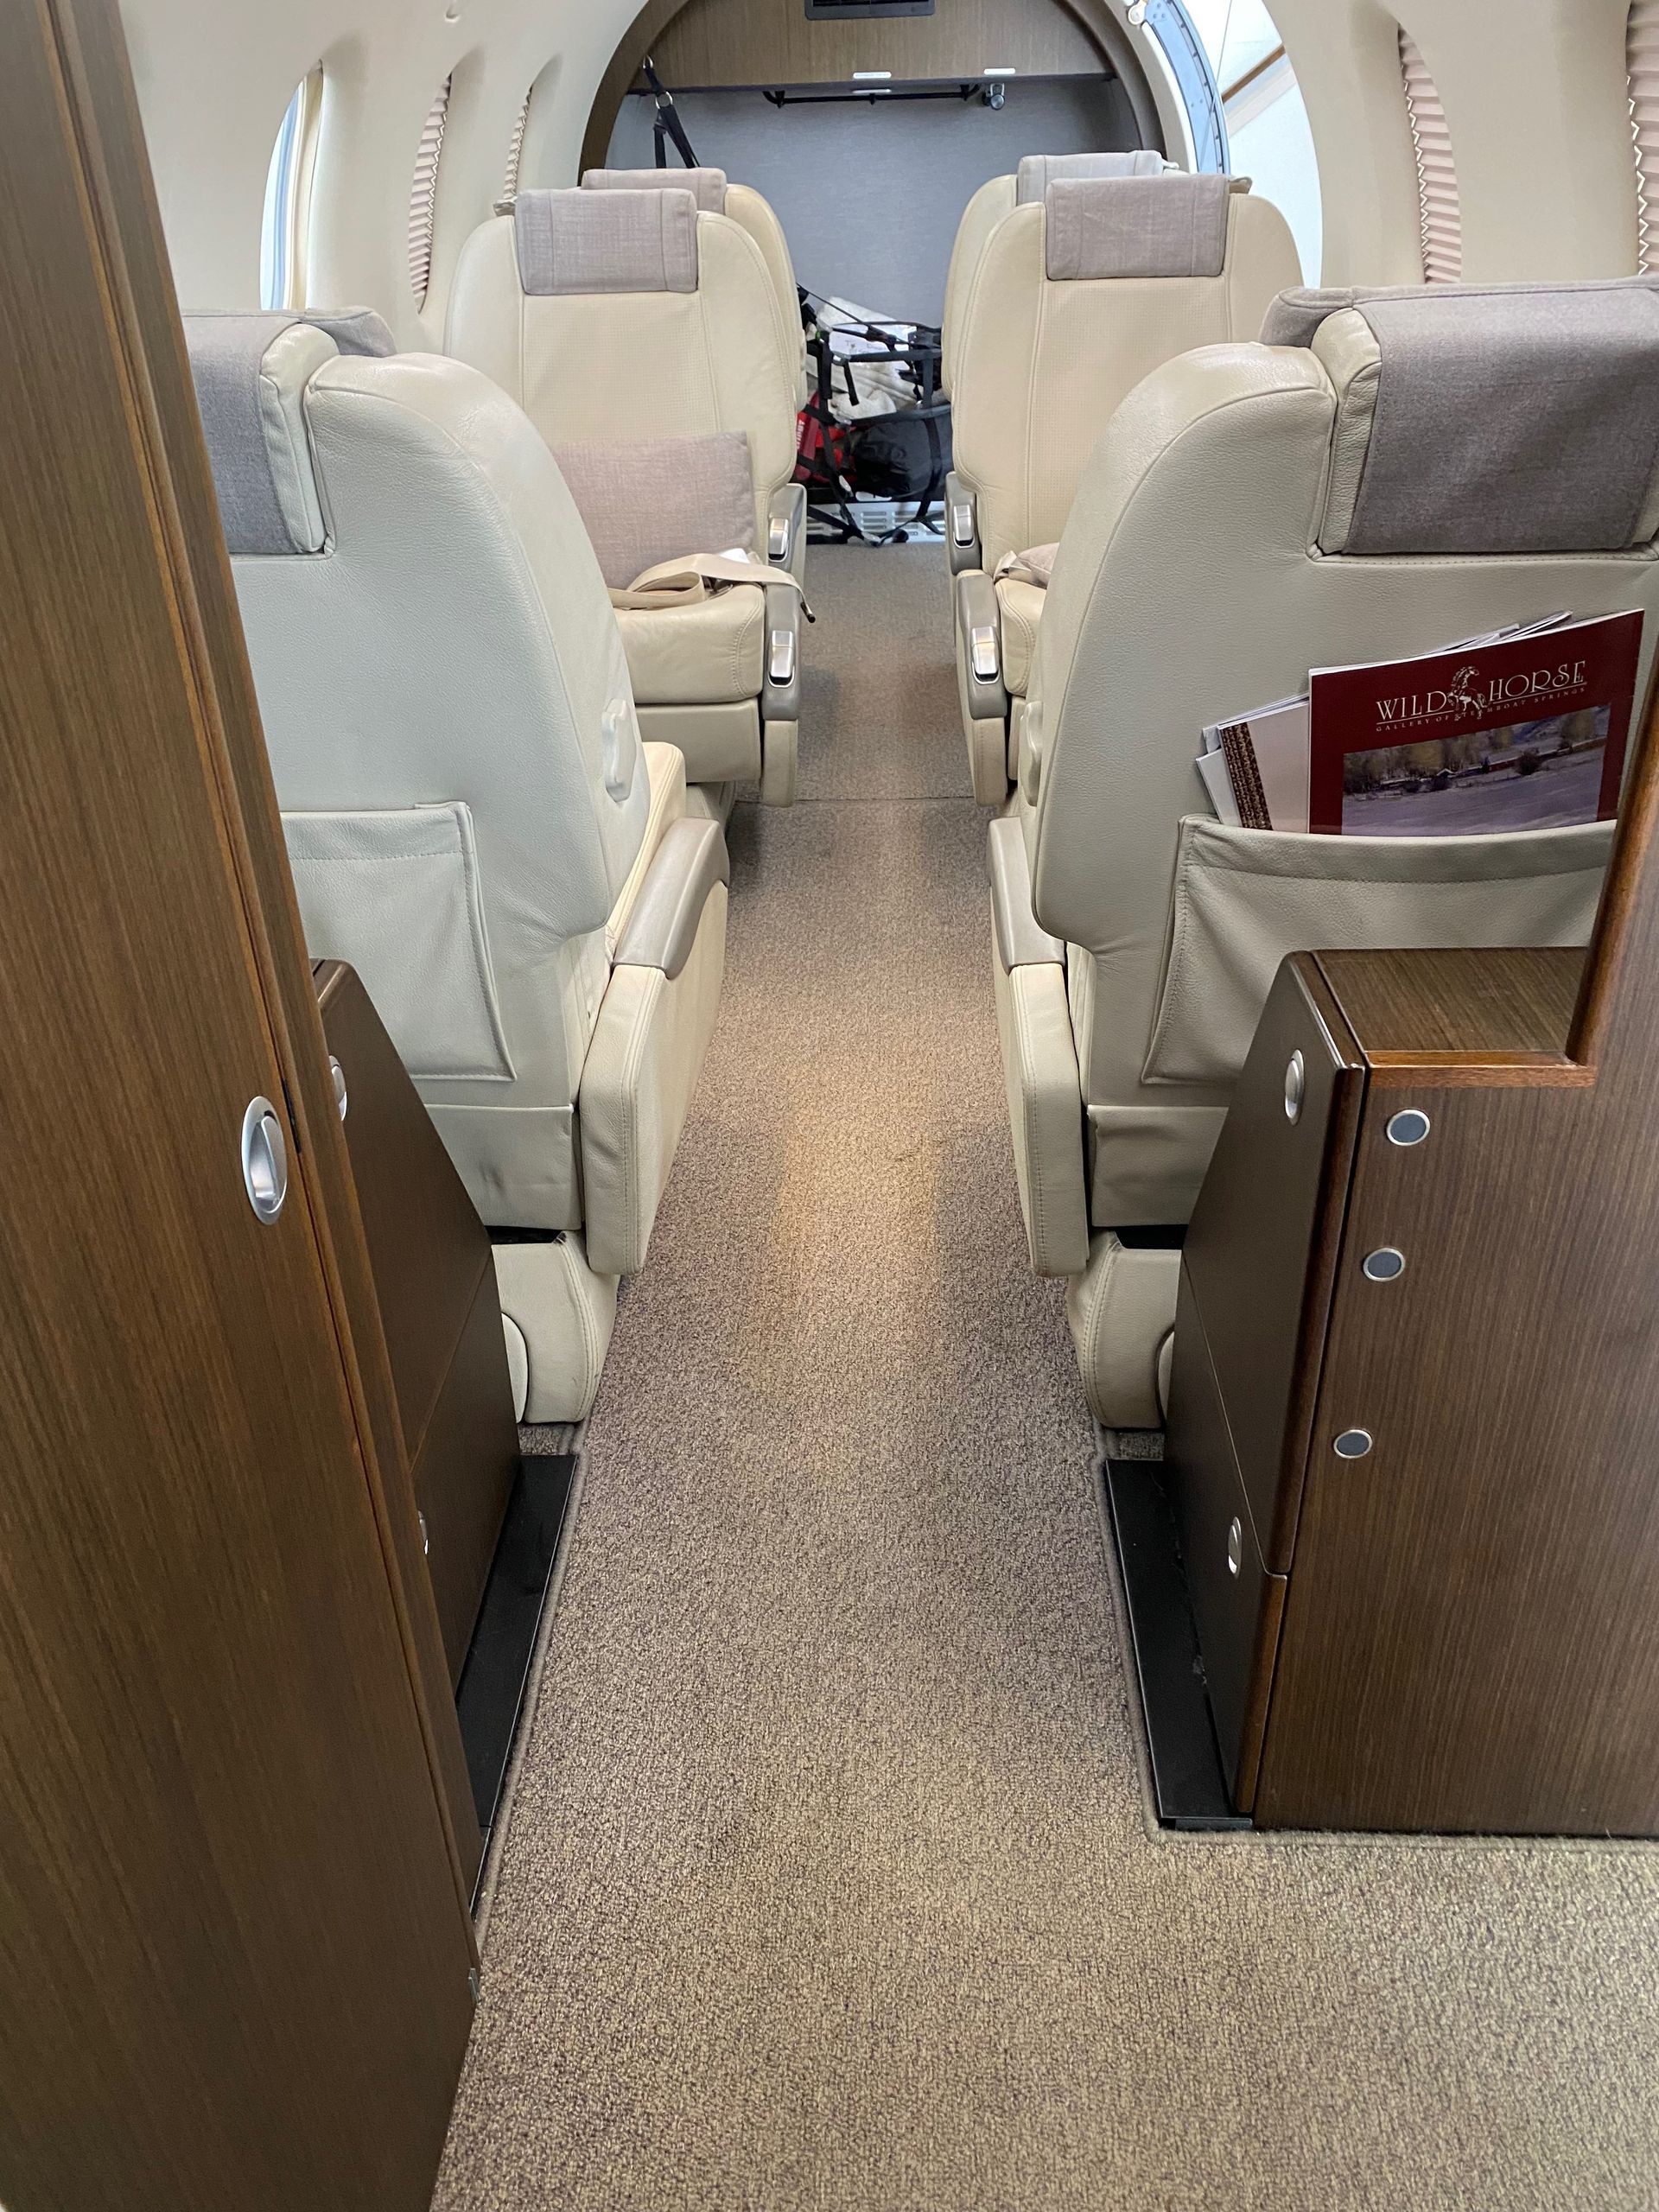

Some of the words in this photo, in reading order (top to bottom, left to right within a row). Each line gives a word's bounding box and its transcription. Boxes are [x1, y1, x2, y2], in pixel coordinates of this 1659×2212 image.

[1376, 690, 1447, 721] WILD
[1489, 660, 1586, 702] HORSE
[1376, 718, 1431, 732] GALLERY
[1435, 714, 1449, 723] OF
[1454, 698, 1527, 719] STEMBOAT
[1533, 686, 1586, 704] SPRINGS
